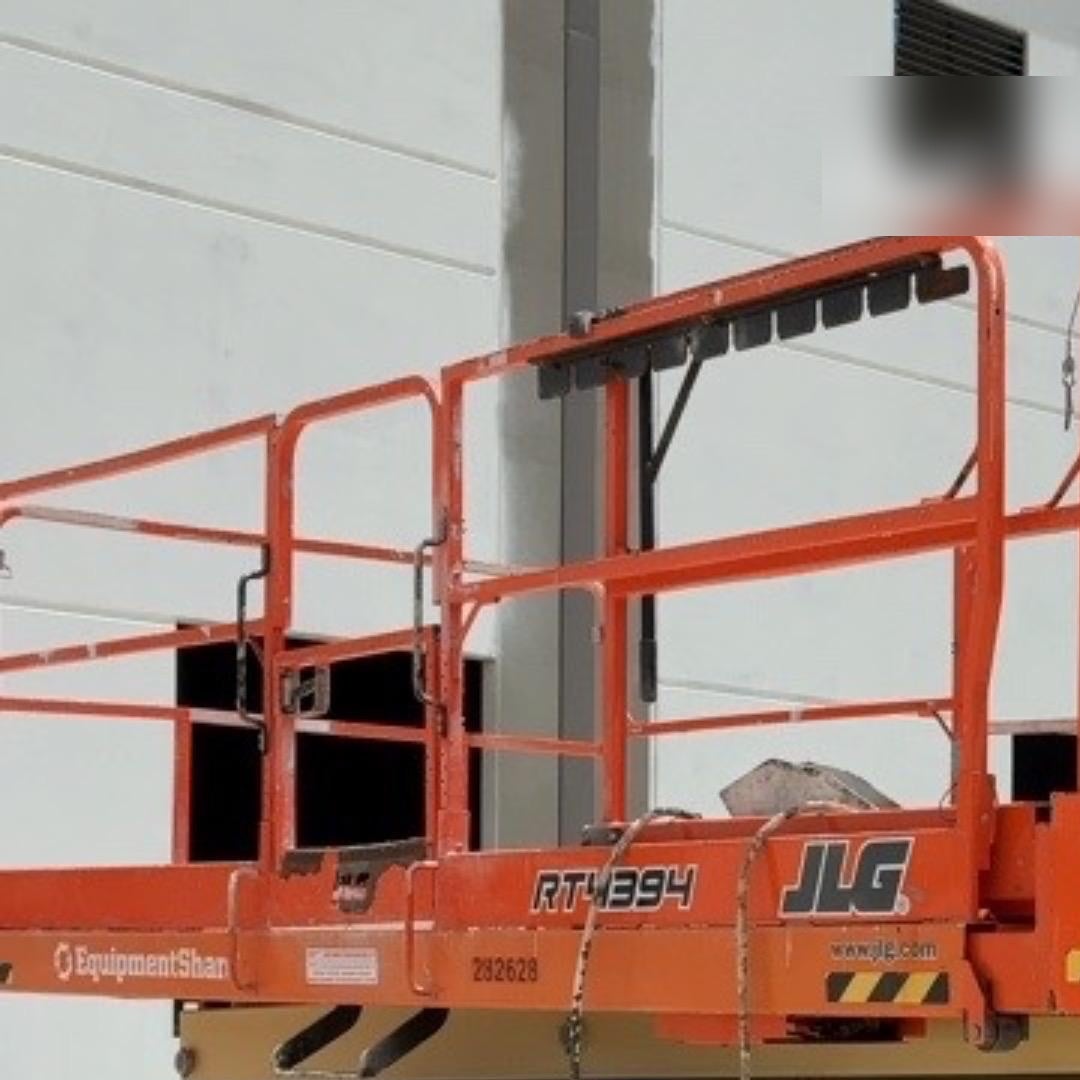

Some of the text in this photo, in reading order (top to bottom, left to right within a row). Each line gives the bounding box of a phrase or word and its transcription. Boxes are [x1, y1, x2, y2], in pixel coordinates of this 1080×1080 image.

[530, 864, 698, 914] RT4394
[778, 837, 913, 918] JLG
[473, 956, 539, 983] 282628
